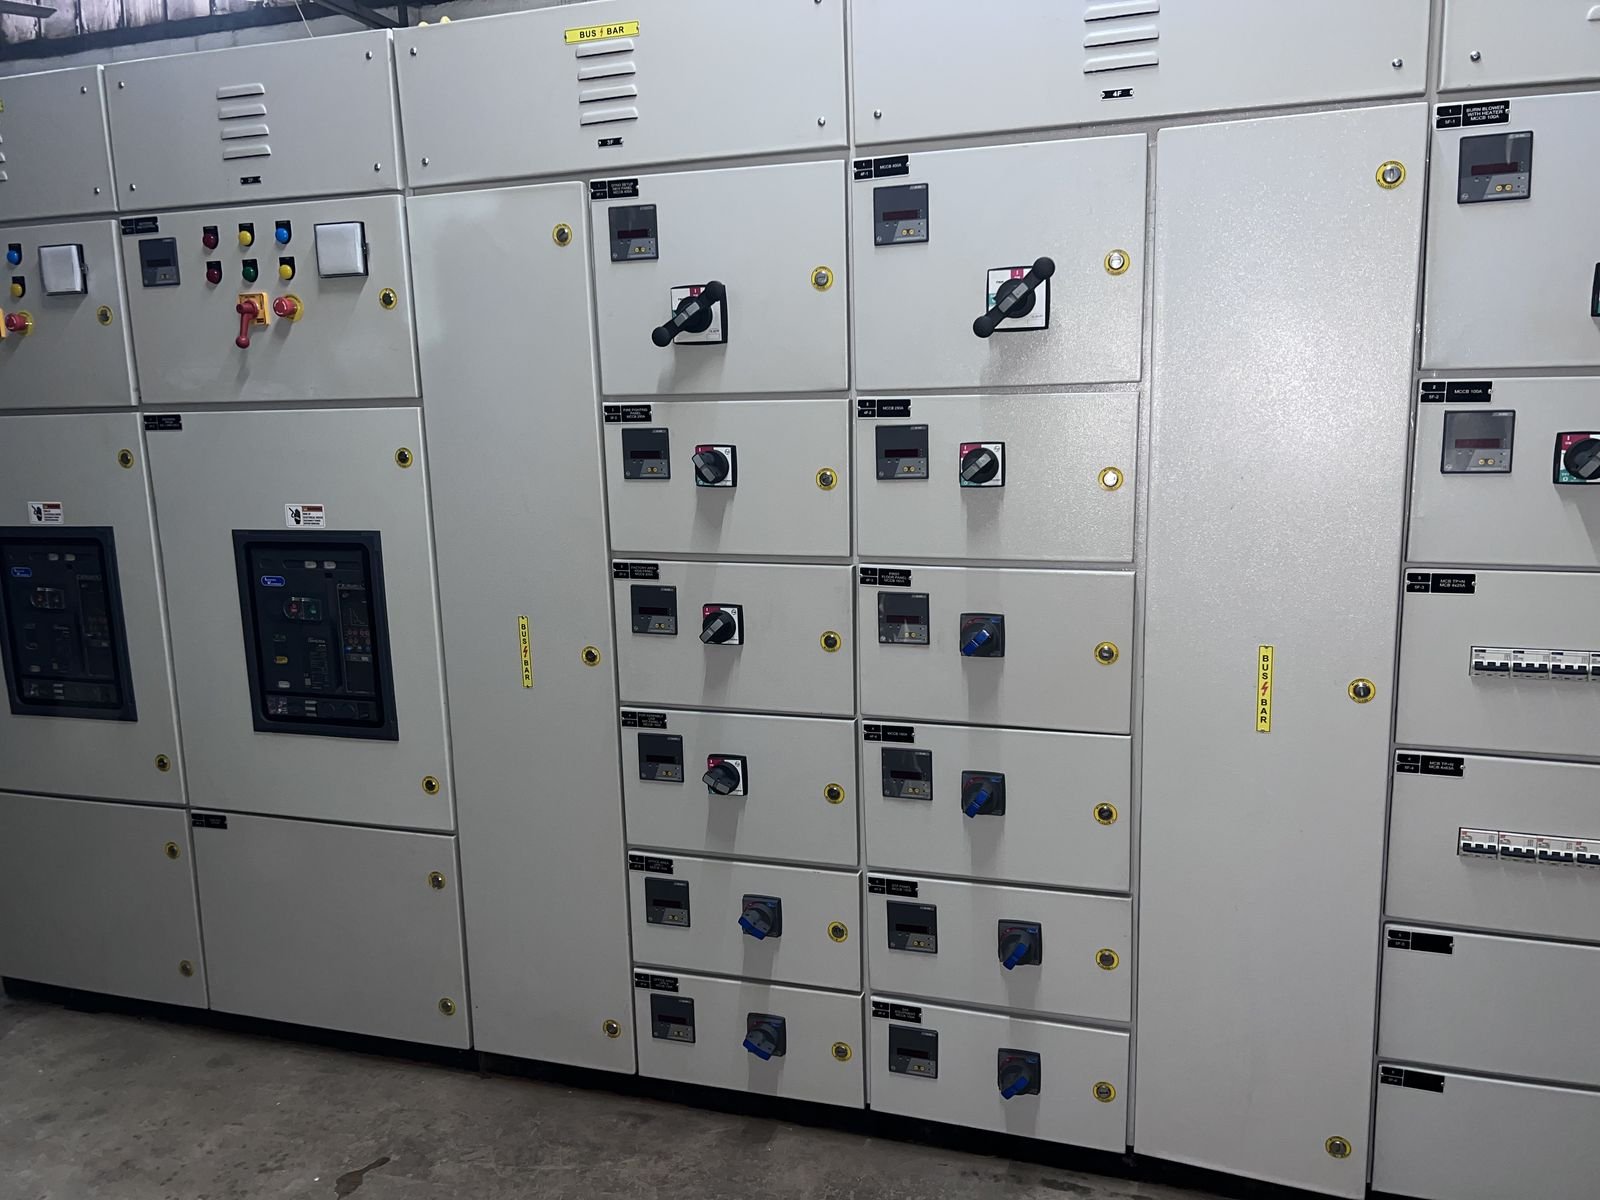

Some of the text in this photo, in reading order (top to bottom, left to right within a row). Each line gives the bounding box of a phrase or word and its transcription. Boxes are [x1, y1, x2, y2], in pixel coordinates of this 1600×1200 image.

[579, 26, 624, 39] BUS BAR
[1466, 104, 1505, 114] BURN BLOWER
[1467, 108, 1504, 118] WITH HEATER
[1260, 699, 1268, 723] BAR
